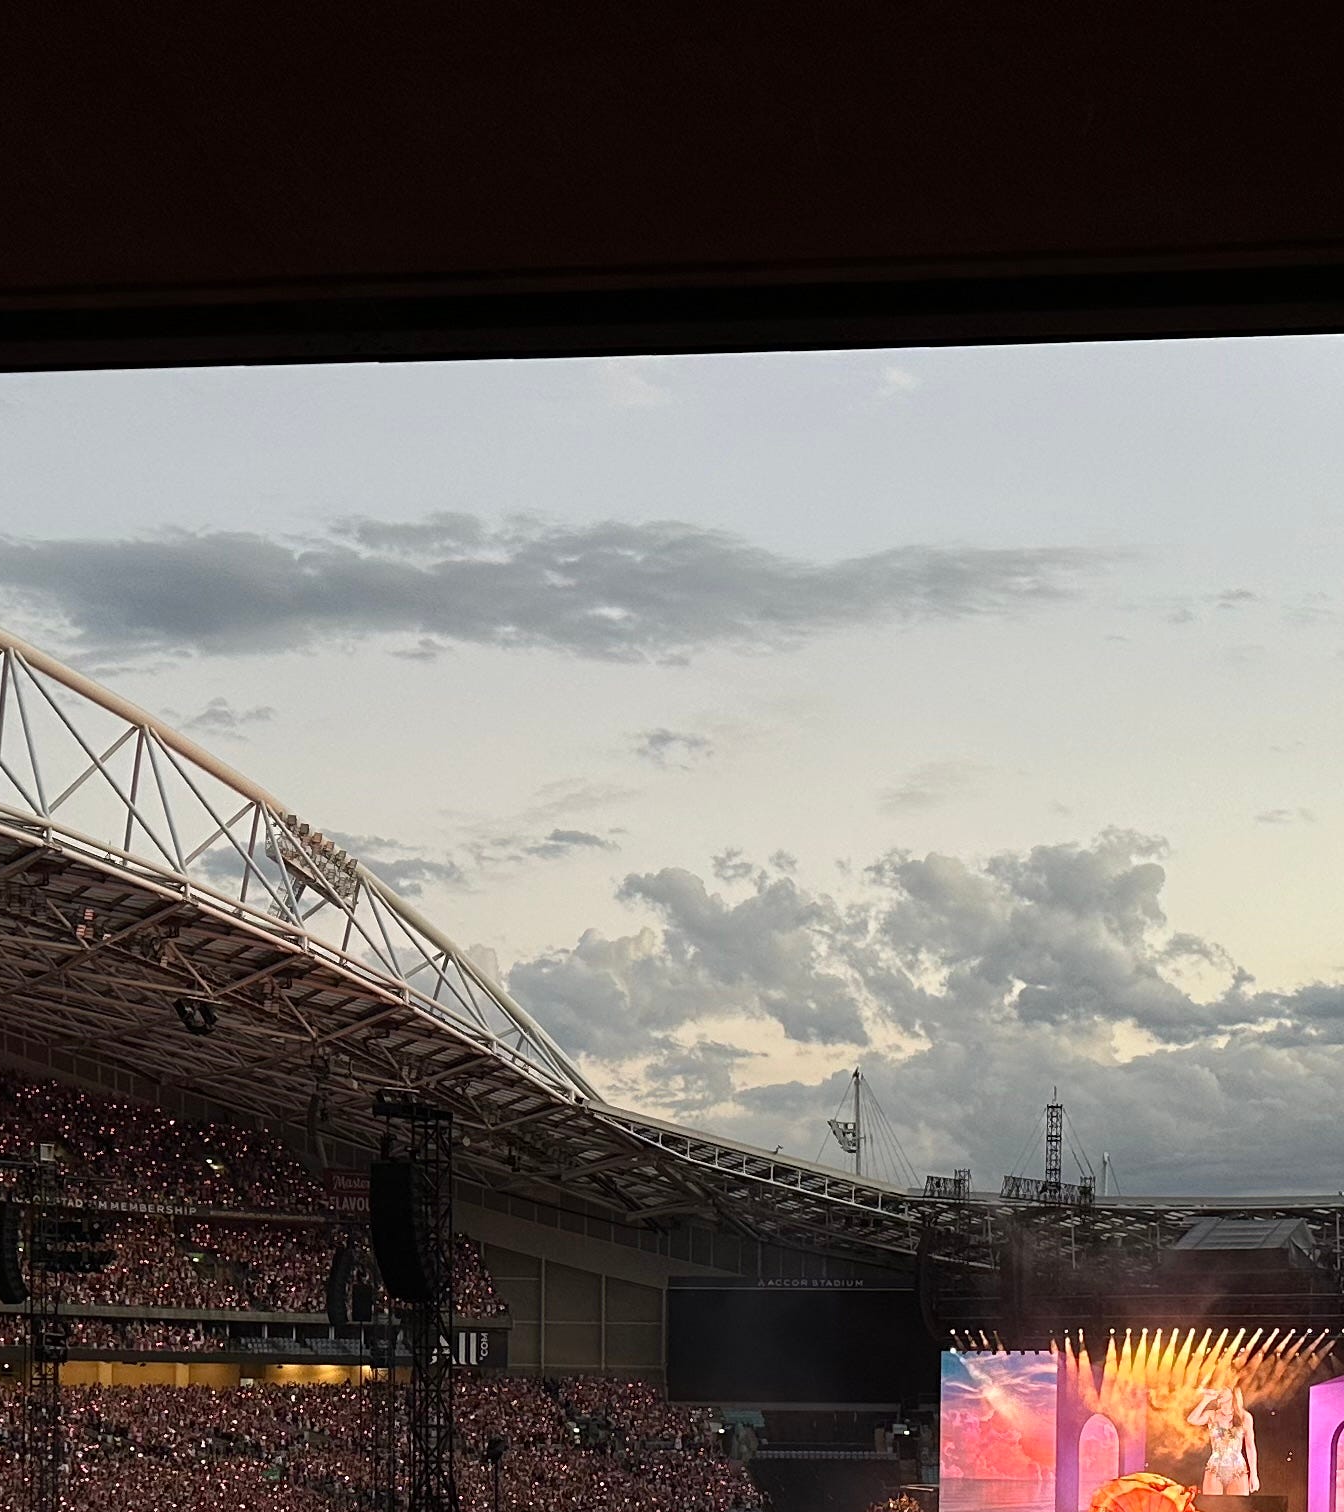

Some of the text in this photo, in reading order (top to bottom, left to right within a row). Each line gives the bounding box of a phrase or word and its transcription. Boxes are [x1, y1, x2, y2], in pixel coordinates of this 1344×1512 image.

[110, 1202, 197, 1215] MEMBERSHIP
[767, 1279, 864, 1287] ACCOR STADIUM
